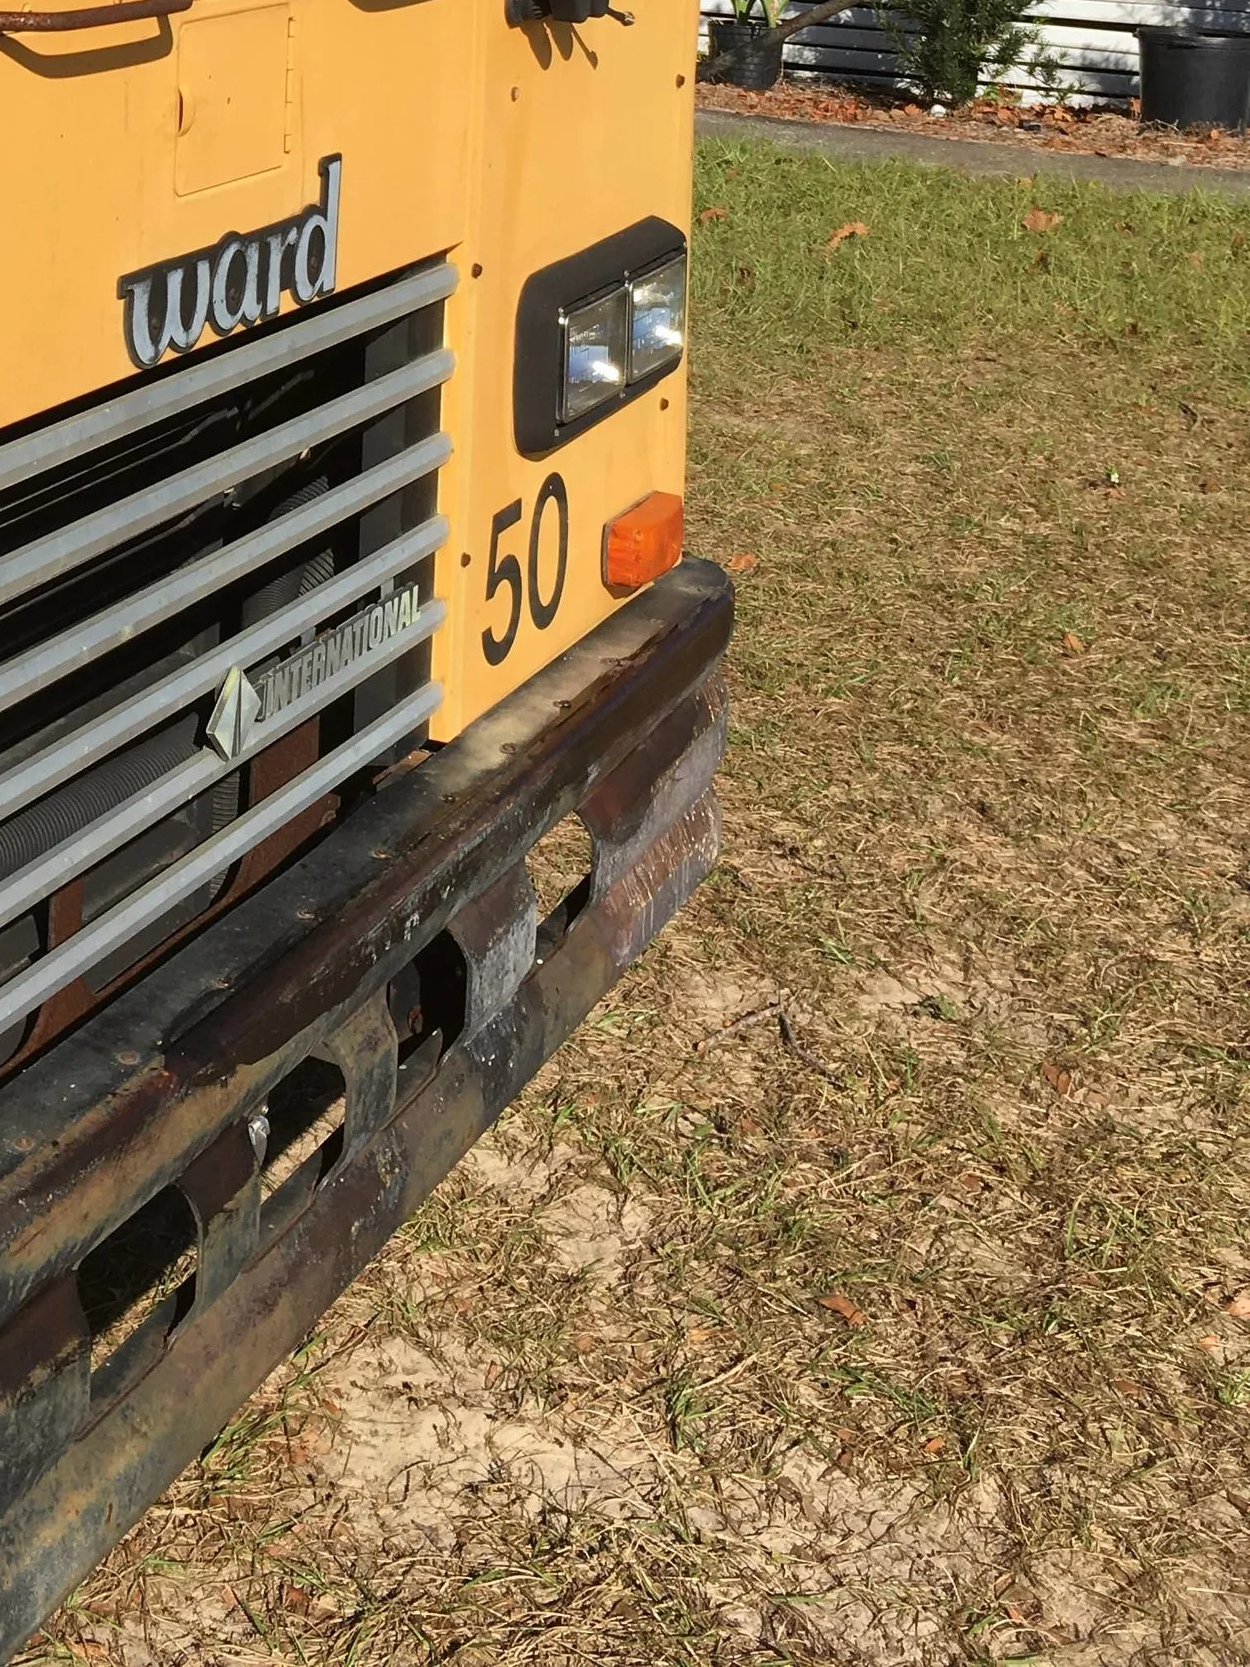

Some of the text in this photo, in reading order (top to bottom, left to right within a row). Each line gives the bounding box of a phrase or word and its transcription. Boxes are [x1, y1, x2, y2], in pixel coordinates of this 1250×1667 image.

[120, 154, 342, 367] ward
[264, 583, 421, 718] INTERNATIONAL
[482, 473, 568, 665] 50
